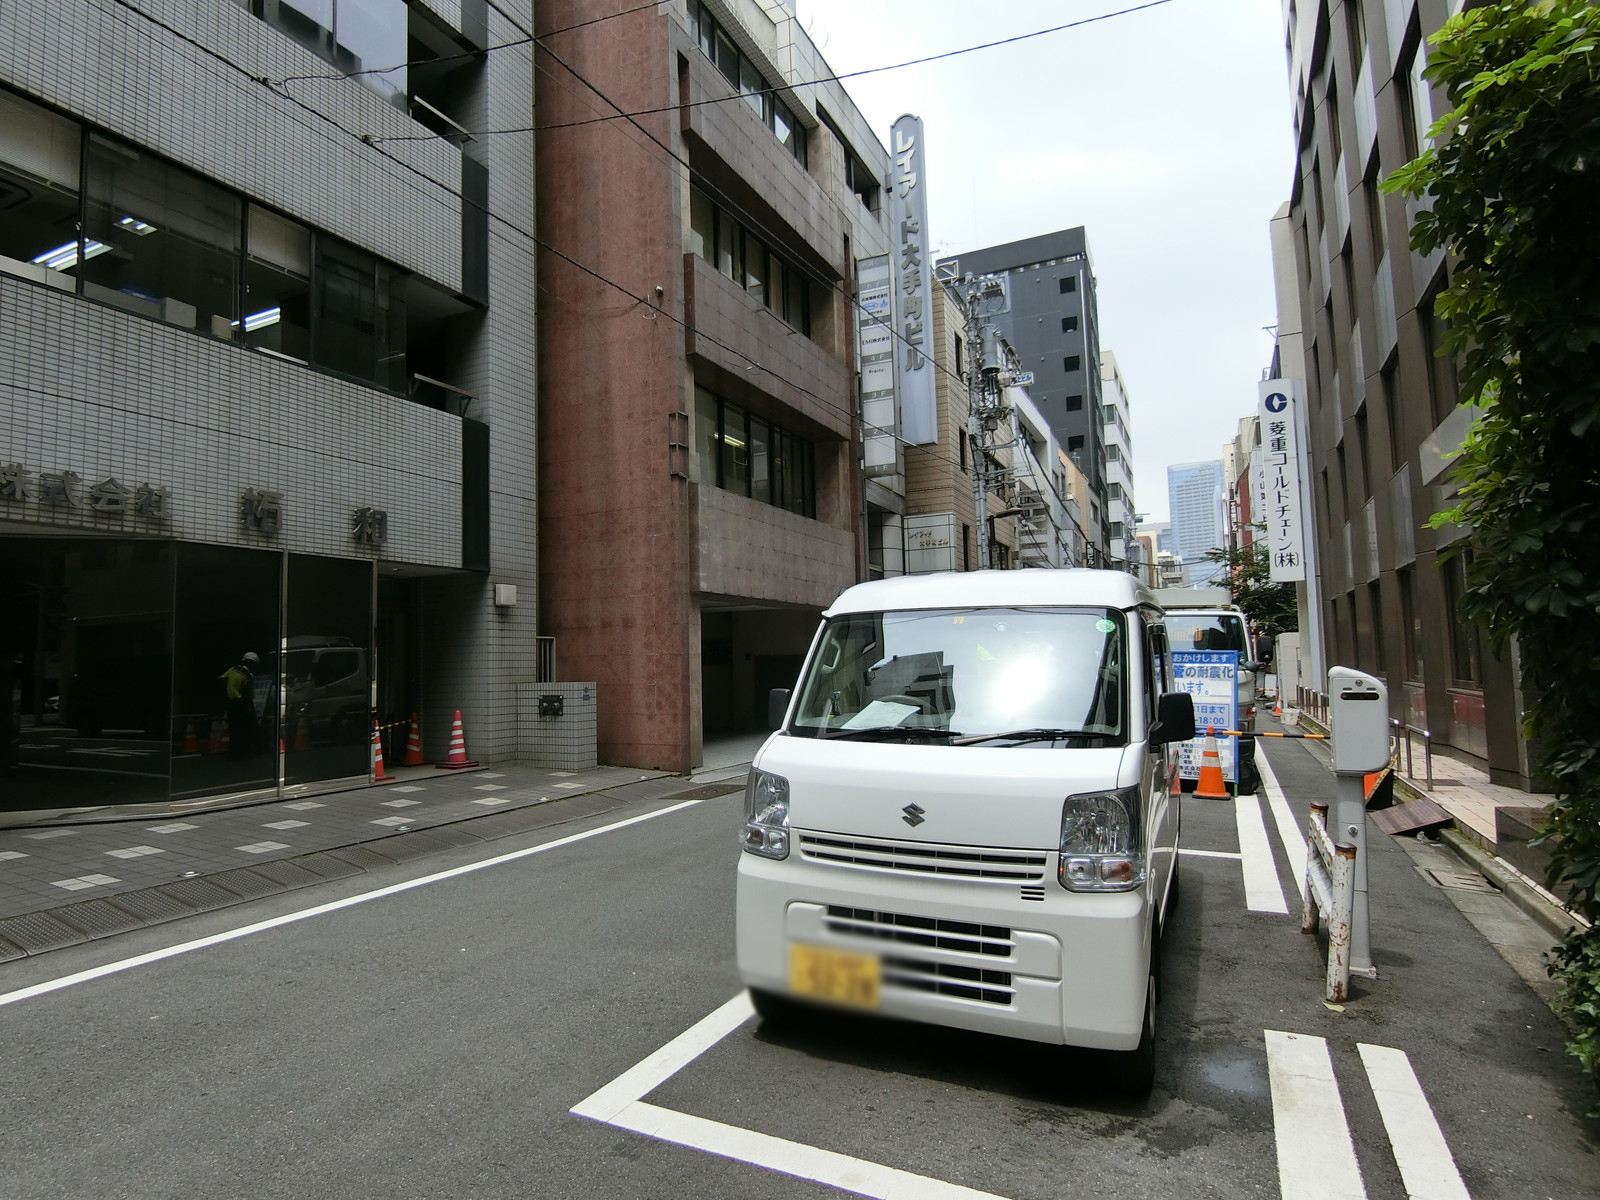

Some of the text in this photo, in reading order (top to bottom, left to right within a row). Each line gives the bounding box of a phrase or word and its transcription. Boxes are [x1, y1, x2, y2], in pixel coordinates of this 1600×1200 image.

[895, 130, 925, 372] レイアード大手町ビル
